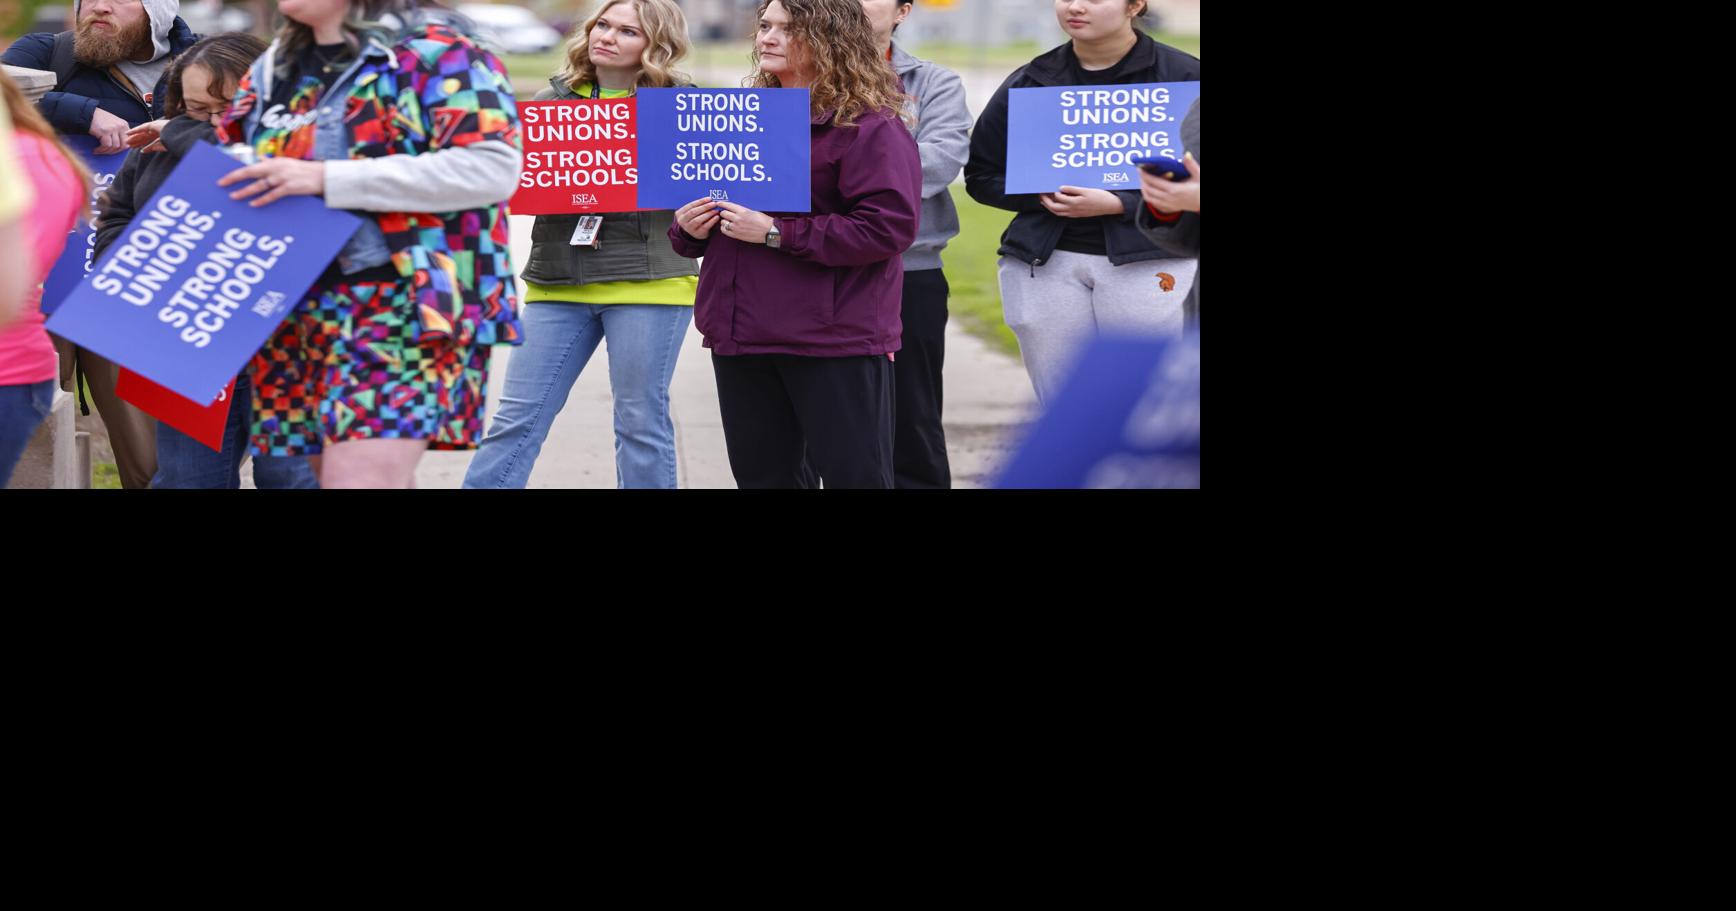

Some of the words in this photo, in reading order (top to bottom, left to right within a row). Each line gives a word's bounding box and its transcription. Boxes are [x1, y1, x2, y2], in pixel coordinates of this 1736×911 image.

[675, 93, 760, 111] STRONG
[1060, 87, 1170, 107] STRONG
[524, 103, 630, 123] STRONG
[677, 114, 764, 132] UNIONS.
[1062, 106, 1175, 126] UNIONS.
[527, 122, 637, 143] UNIONS.
[1059, 131, 1169, 150] STRONG
[526, 149, 633, 169] STRONG
[675, 142, 760, 161] STRONG
[520, 167, 638, 188] SCHOOLS
[670, 163, 772, 182] SCHOOLS.
[1103, 172, 1129, 182] ISEA
[571, 193, 598, 204] ISEA
[709, 189, 729, 200] ISEA
[91, 194, 191, 296] STRONG
[120, 211, 222, 307] UNIONS.
[157, 227, 257, 328] STRONG
[180, 235, 295, 348] SCHOOLS.
